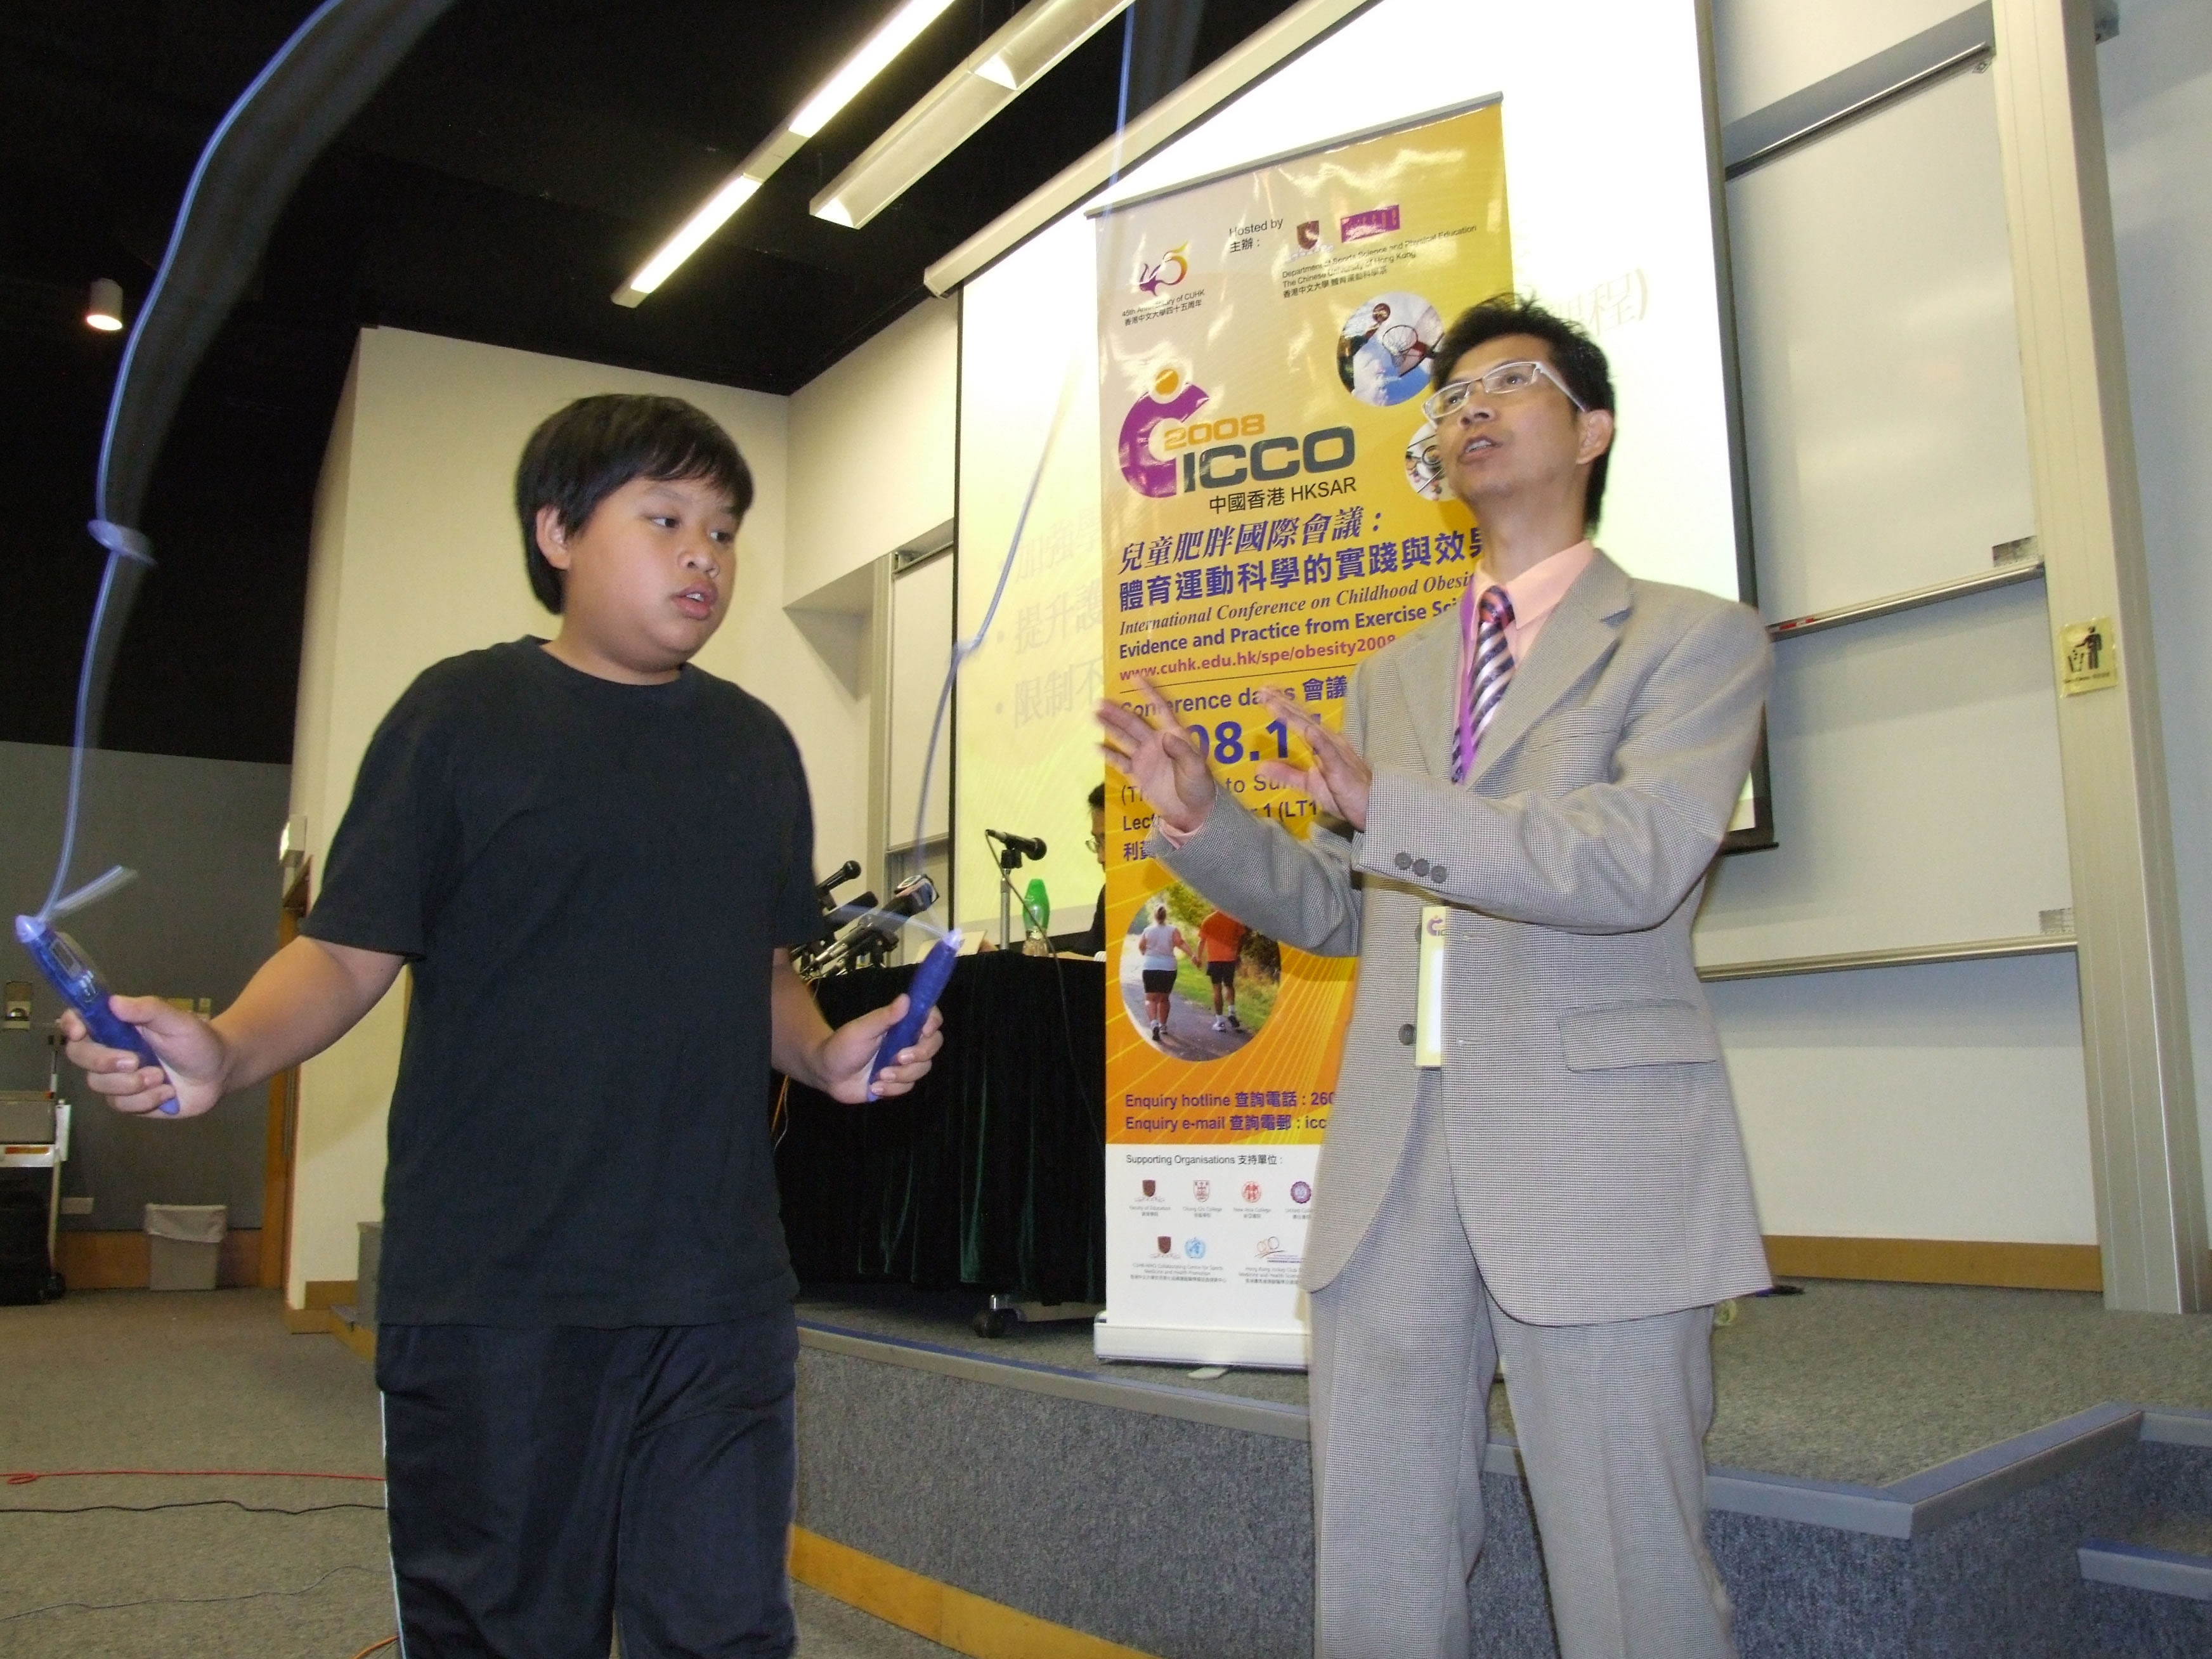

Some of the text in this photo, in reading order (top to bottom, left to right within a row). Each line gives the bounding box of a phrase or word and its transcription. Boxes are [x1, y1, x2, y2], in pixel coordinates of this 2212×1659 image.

[1229, 219, 1284, 237] Hosted by
[1332, 254, 1356, 268] Sports
[1358, 247, 1387, 259] Science
[1389, 242, 1403, 251] and
[1438, 224, 1476, 238] Education
[1283, 279, 1296, 288] The
[1298, 272, 1326, 285] Chinese
[1374, 255, 1394, 266] Hong
[1396, 251, 1416, 261] Kong
[1184, 289, 1205, 301] CUHK
[1283, 280, 1329, 299] 香港中文大學
[1164, 413, 1265, 451] 2008
[1183, 426, 1355, 493] ICCO
[1209, 476, 1356, 514] 中國香港 HKSAR
[1118, 505, 1381, 575] 兒童肥胖國際會議：
[1119, 607, 1212, 635] International
[1217, 600, 1306, 621] Conference
[1311, 596, 1330, 609] on
[1336, 579, 1419, 606] Childhood
[1119, 637, 1187, 659] Evidence
[1193, 628, 1225, 647] and
[1231, 622, 1299, 643] Practice
[1305, 618, 1350, 634] from
[1355, 606, 1426, 628] Exercise
[1121, 693, 1232, 719] Conerence
[1225, 777, 1245, 793] to
[1263, 803, 1271, 817] 1
[1126, 1094, 1177, 1110] Enquiry
[1182, 1093, 1230, 1107] hotline
[1126, 1117, 1178, 1132] Enquiry
[1183, 1116, 1225, 1129] e-mail
[1126, 1154, 1172, 1166] Supporting
[1174, 1154, 1235, 1165] Organisations
